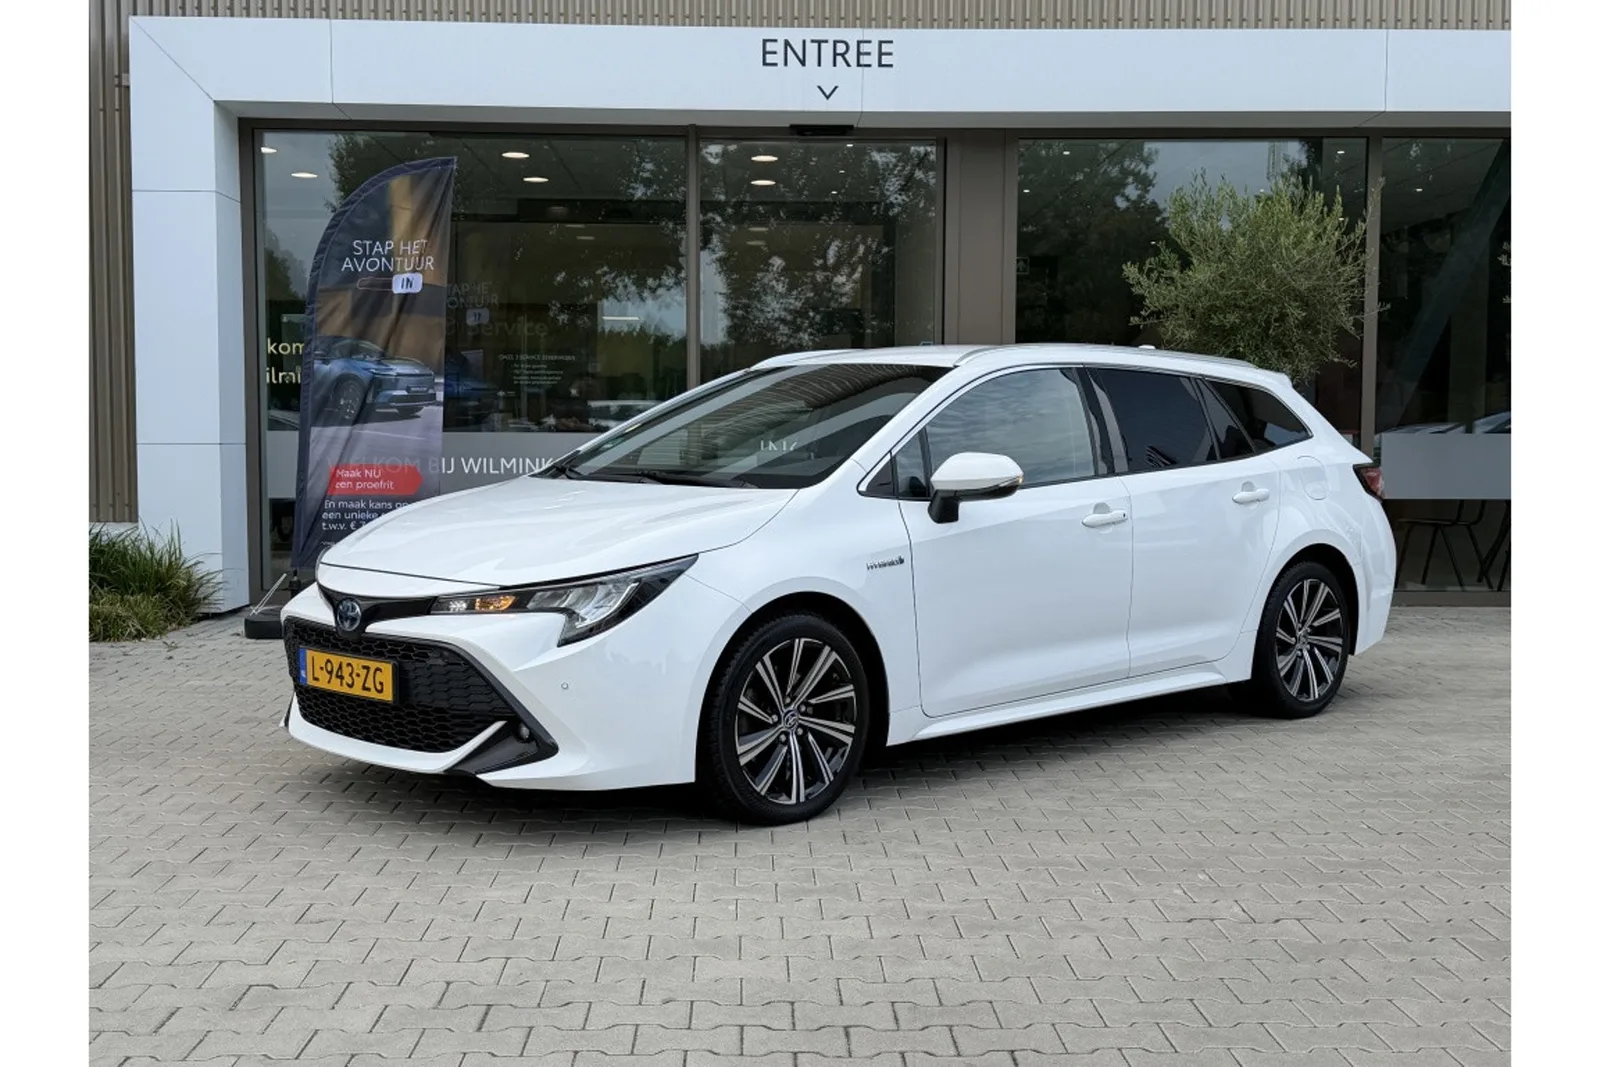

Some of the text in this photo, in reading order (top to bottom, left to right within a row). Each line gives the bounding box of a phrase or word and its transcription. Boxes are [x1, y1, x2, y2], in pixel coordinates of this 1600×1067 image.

[762, 38, 894, 68] ENTREE
[353, 239, 429, 256] STAP HET
[341, 256, 435, 272] AVONTUUR
[400, 277, 415, 289] IN
[335, 469, 382, 478] Maak NU
[355, 480, 394, 491] proefrit
[324, 500, 336, 509] En
[338, 500, 367, 509] maak
[368, 500, 393, 509] kans
[322, 511, 341, 520] een
[344, 510, 379, 520] unieke
[321, 522, 347, 531] t.w.v.
[311, 655, 385, 694] L-943-ZG
